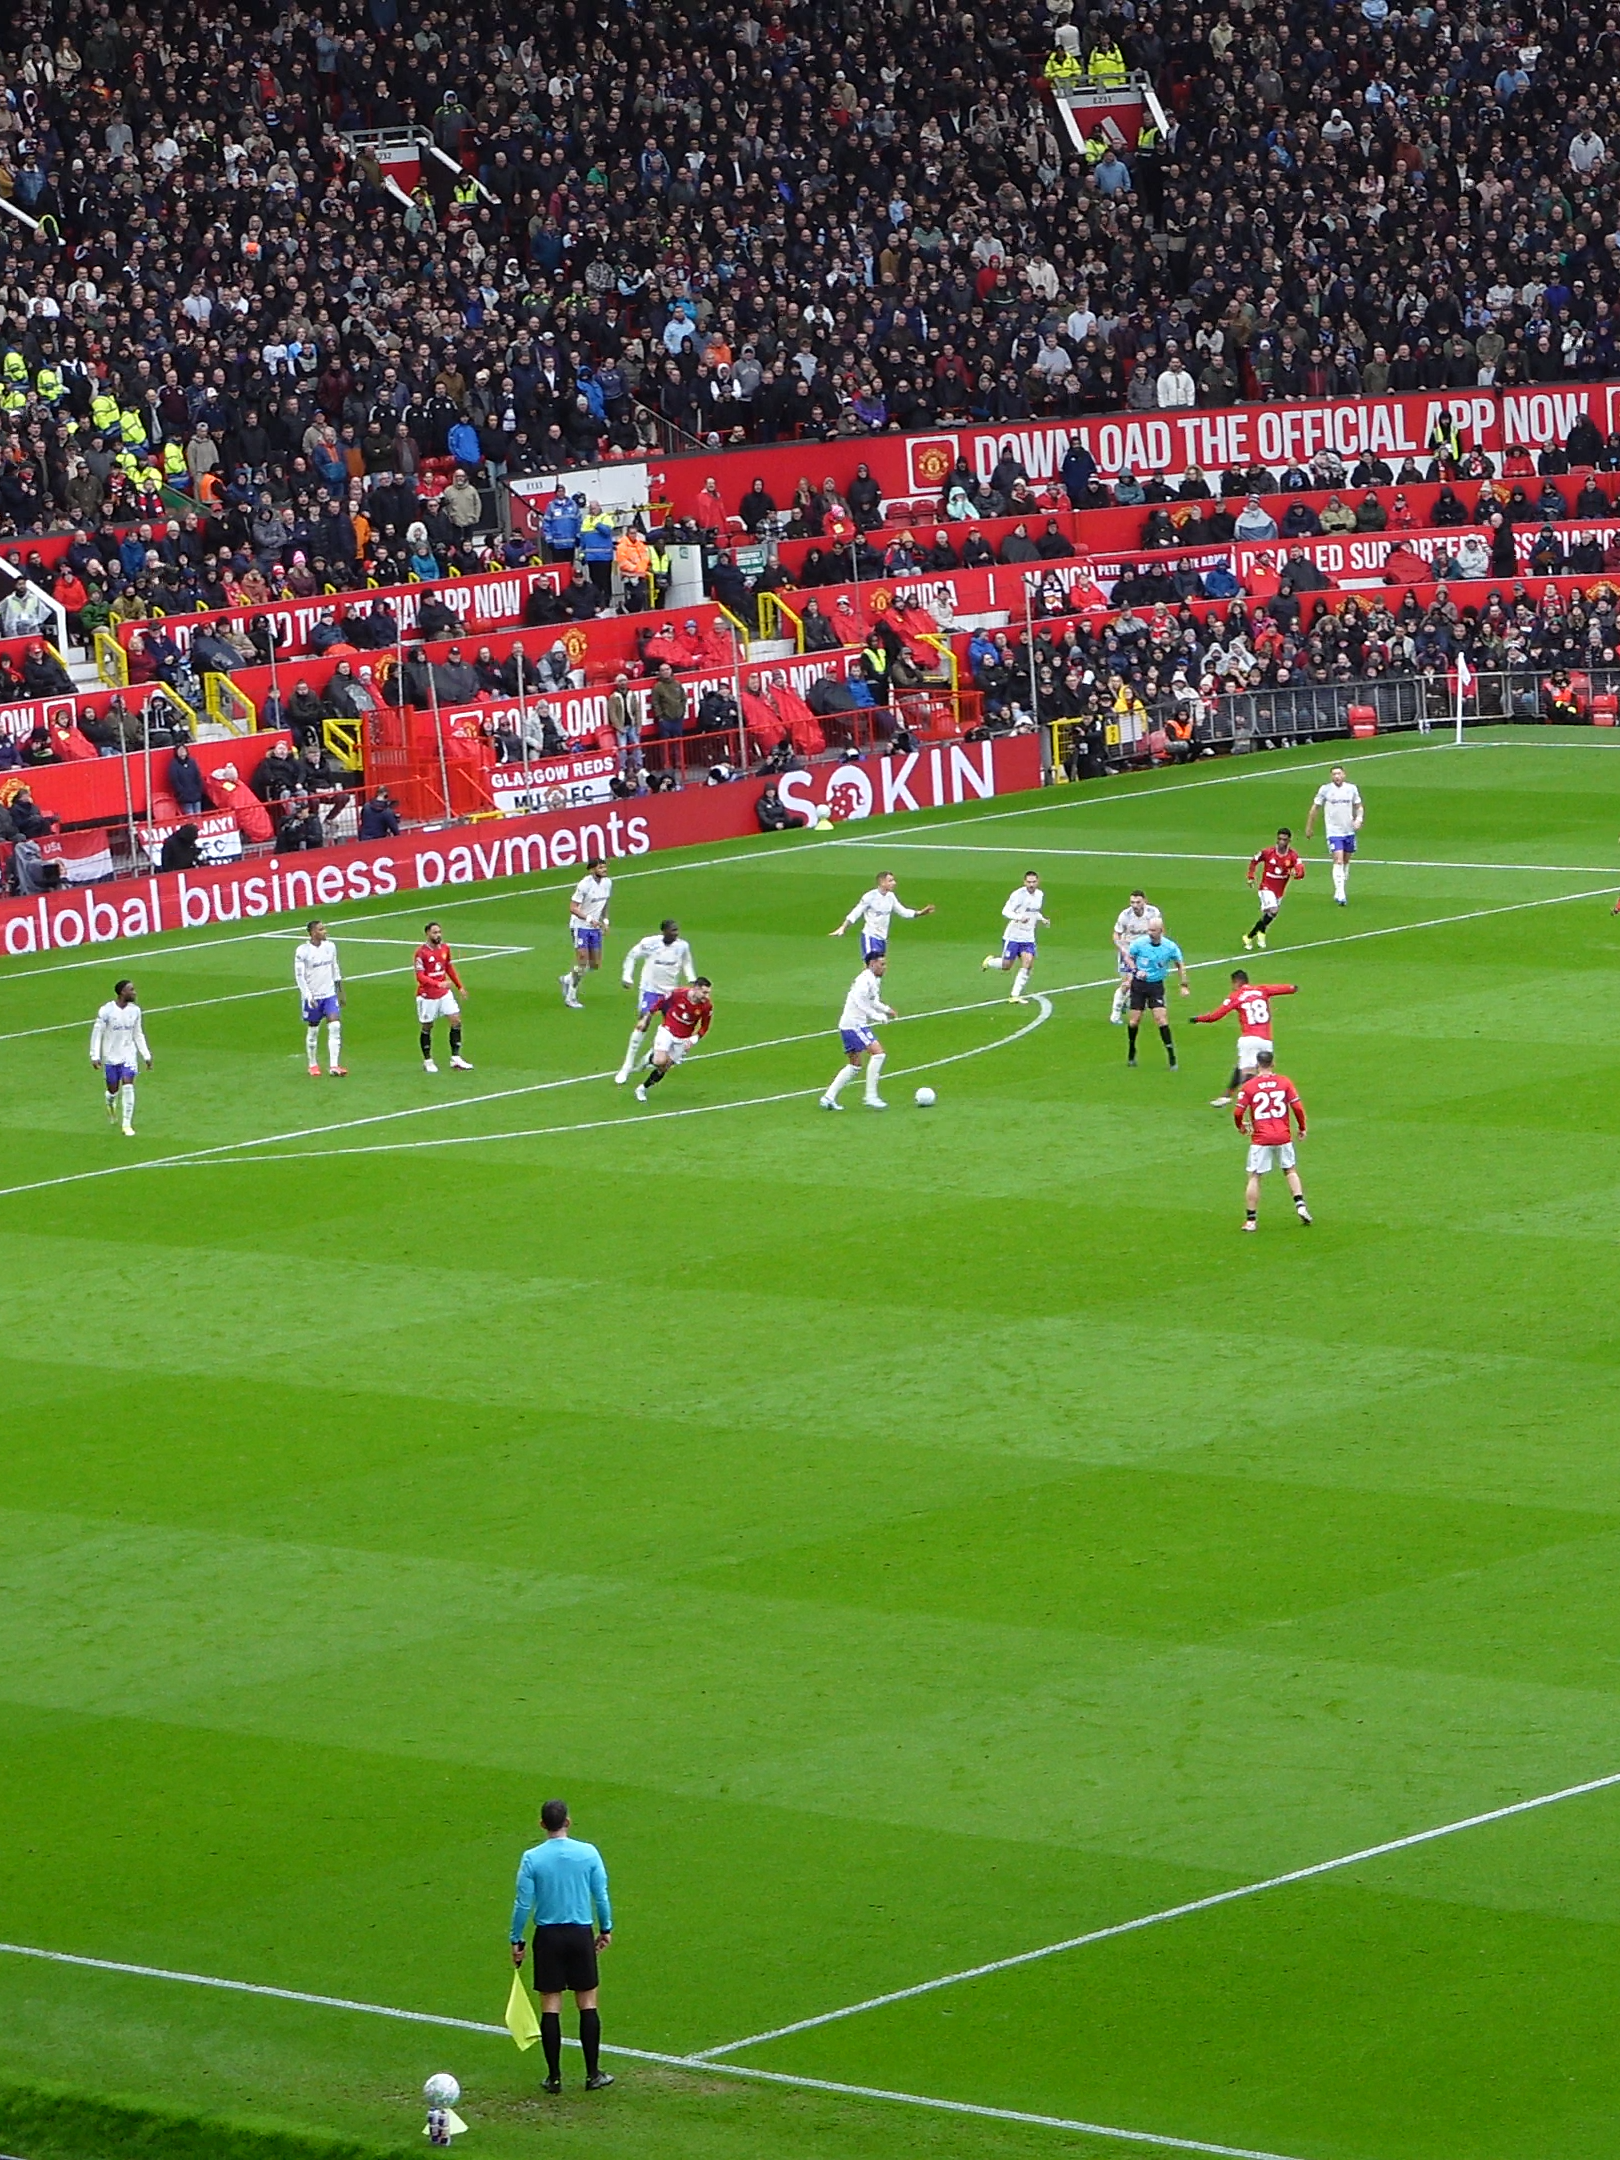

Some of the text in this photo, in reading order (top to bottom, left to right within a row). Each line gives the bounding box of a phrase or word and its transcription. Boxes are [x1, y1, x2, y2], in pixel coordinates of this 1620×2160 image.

[1178, 414, 1251, 464] THE
[1258, 404, 1416, 460] OFFICIAL
[1425, 398, 1496, 449] APP
[1503, 392, 1589, 444] NOW
[1241, 543, 1344, 578] DSALED
[1349, 534, 1488, 570] SUPRTE
[294, 604, 336, 645] TH
[474, 579, 521, 619] NOW
[0, 707, 34, 744] OW
[491, 756, 615, 788] GLASGOW REDS
[778, 740, 995, 828] SOKIN
[5, 811, 651, 955] global business payments
[1241, 999, 1269, 1026] 18
[1252, 1090, 1288, 1121] 23
